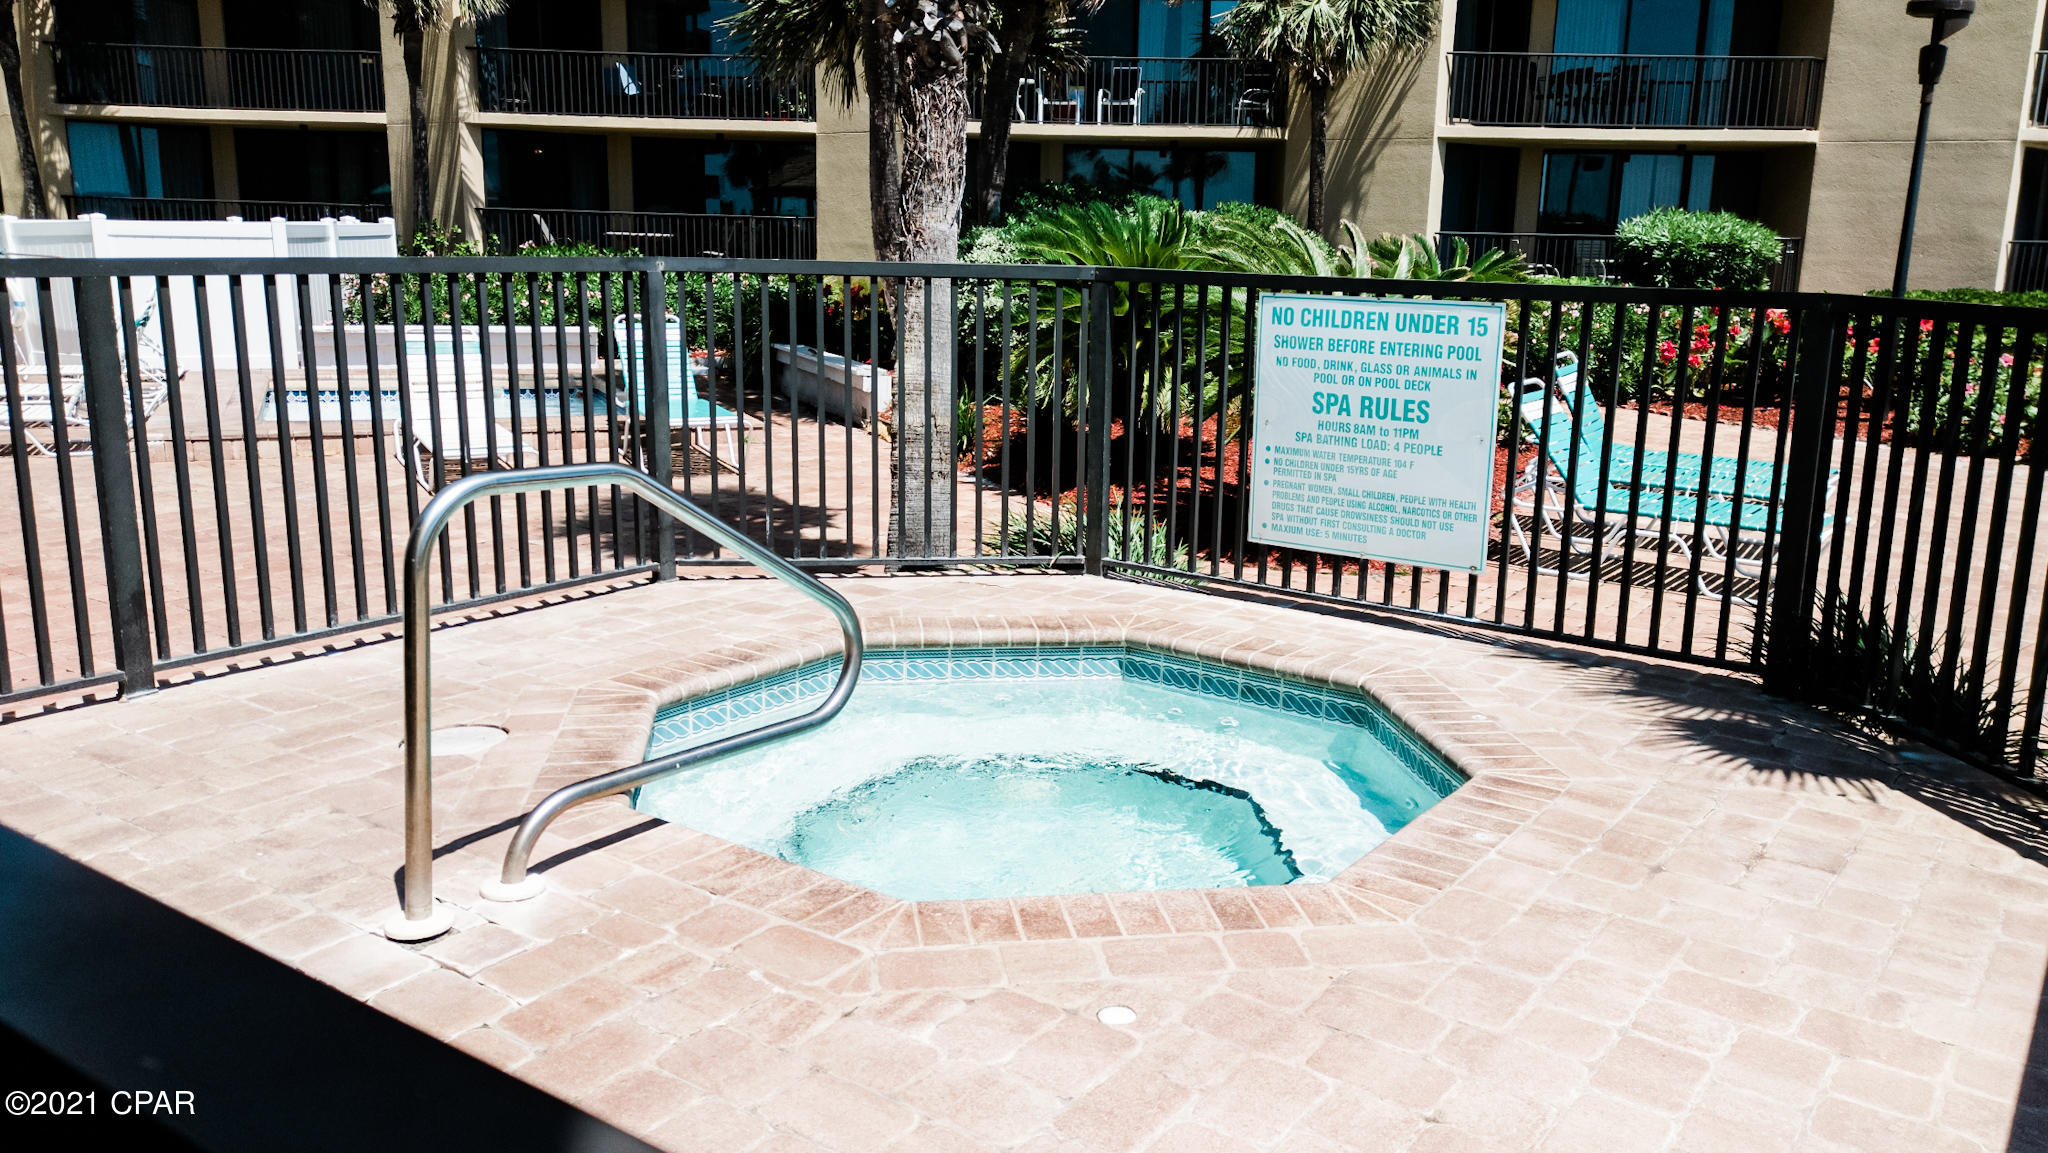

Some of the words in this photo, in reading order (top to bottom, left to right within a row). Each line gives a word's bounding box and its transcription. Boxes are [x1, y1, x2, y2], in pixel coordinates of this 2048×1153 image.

[1272, 307, 1294, 326] NO
[1301, 308, 1390, 331] CHILDREN
[1395, 313, 1459, 335] UNDER
[1468, 317, 1488, 337] 15
[1274, 335, 1323, 350] SHOWER
[1328, 339, 1375, 354] BEFORE
[1380, 341, 1443, 359] ENTERING
[1447, 346, 1482, 361] POOL
[1276, 356, 1288, 367] NO
[1361, 362, 1392, 375] GLASS
[1396, 365, 1410, 376] OR
[1414, 366, 1462, 379] ANIMALS
[1466, 369, 1477, 380] IN
[1314, 373, 1338, 385] POOL
[1342, 375, 1355, 386] OR
[1358, 376, 1371, 387] ON
[1375, 377, 1400, 389] POOL
[1405, 380, 1431, 392] DECK
[1312, 392, 1351, 417] SPA
[1360, 396, 1430, 423] RULES
[1318, 420, 1351, 433] HOURS
[1353, 425, 1377, 436] 8AM
[1379, 427, 1389, 437] to
[1394, 428, 1419, 439] 11PM
[1295, 432, 1312, 443] SPA
[1316, 434, 1358, 448] BATHING
[1361, 439, 1390, 451] LOAD:
[1394, 442, 1400, 452] 4
[1404, 443, 1443, 456] PEOPLE
[1273, 458, 1283, 466] NO
[1285, 459, 1319, 471] CHILDREN
[1321, 462, 1345, 474] UNDER
[1371, 468, 1380, 477] OF
[1383, 469, 1398, 479] AGE
[1275, 445, 1310, 458] MAXIMUM
[1313, 450, 1336, 460] WATER
[1339, 453, 1391, 467] TEMPERATURE
[1410, 461, 1414, 469] F
[1273, 468, 1312, 480] PERMITTED
[1315, 472, 1322, 480] IN
[1324, 473, 1336, 482] SPA
[1272, 491, 1305, 502] PROBLEMS
[1307, 495, 1320, 504] AND
[1321, 496, 1345, 507] PEOPLE
[1347, 499, 1366, 509] USING
[1402, 506, 1440, 518] NARCOTICS
[1443, 510, 1452, 519] OR
[1454, 512, 1477, 522] OTHER
[1337, 487, 1360, 497] SMALL
[1400, 494, 1426, 505] PEOPLE
[1429, 498, 1447, 508] WITH
[1449, 500, 1477, 511] HEALTH
[1272, 502, 1295, 512] DRUGS
[1297, 504, 1314, 514] THAT
[1316, 506, 1339, 517] CAUSE
[1341, 509, 1388, 523] DROWSINESS
[1390, 516, 1419, 527] SHOULD
[1422, 520, 1437, 530] NOT
[1439, 522, 1454, 532] USE
[1272, 511, 1284, 520] SPA
[1287, 513, 1318, 526] WITHOUT
[1320, 517, 1339, 528] FIRST
[1342, 521, 1386, 535] CONSULTING
[1389, 527, 1394, 535] A
[1396, 528, 1426, 540] DOCTOR
[1272, 523, 1303, 534] MAXIUM
[1325, 529, 1330, 538] 5
[1332, 530, 1368, 543] MINUTES
